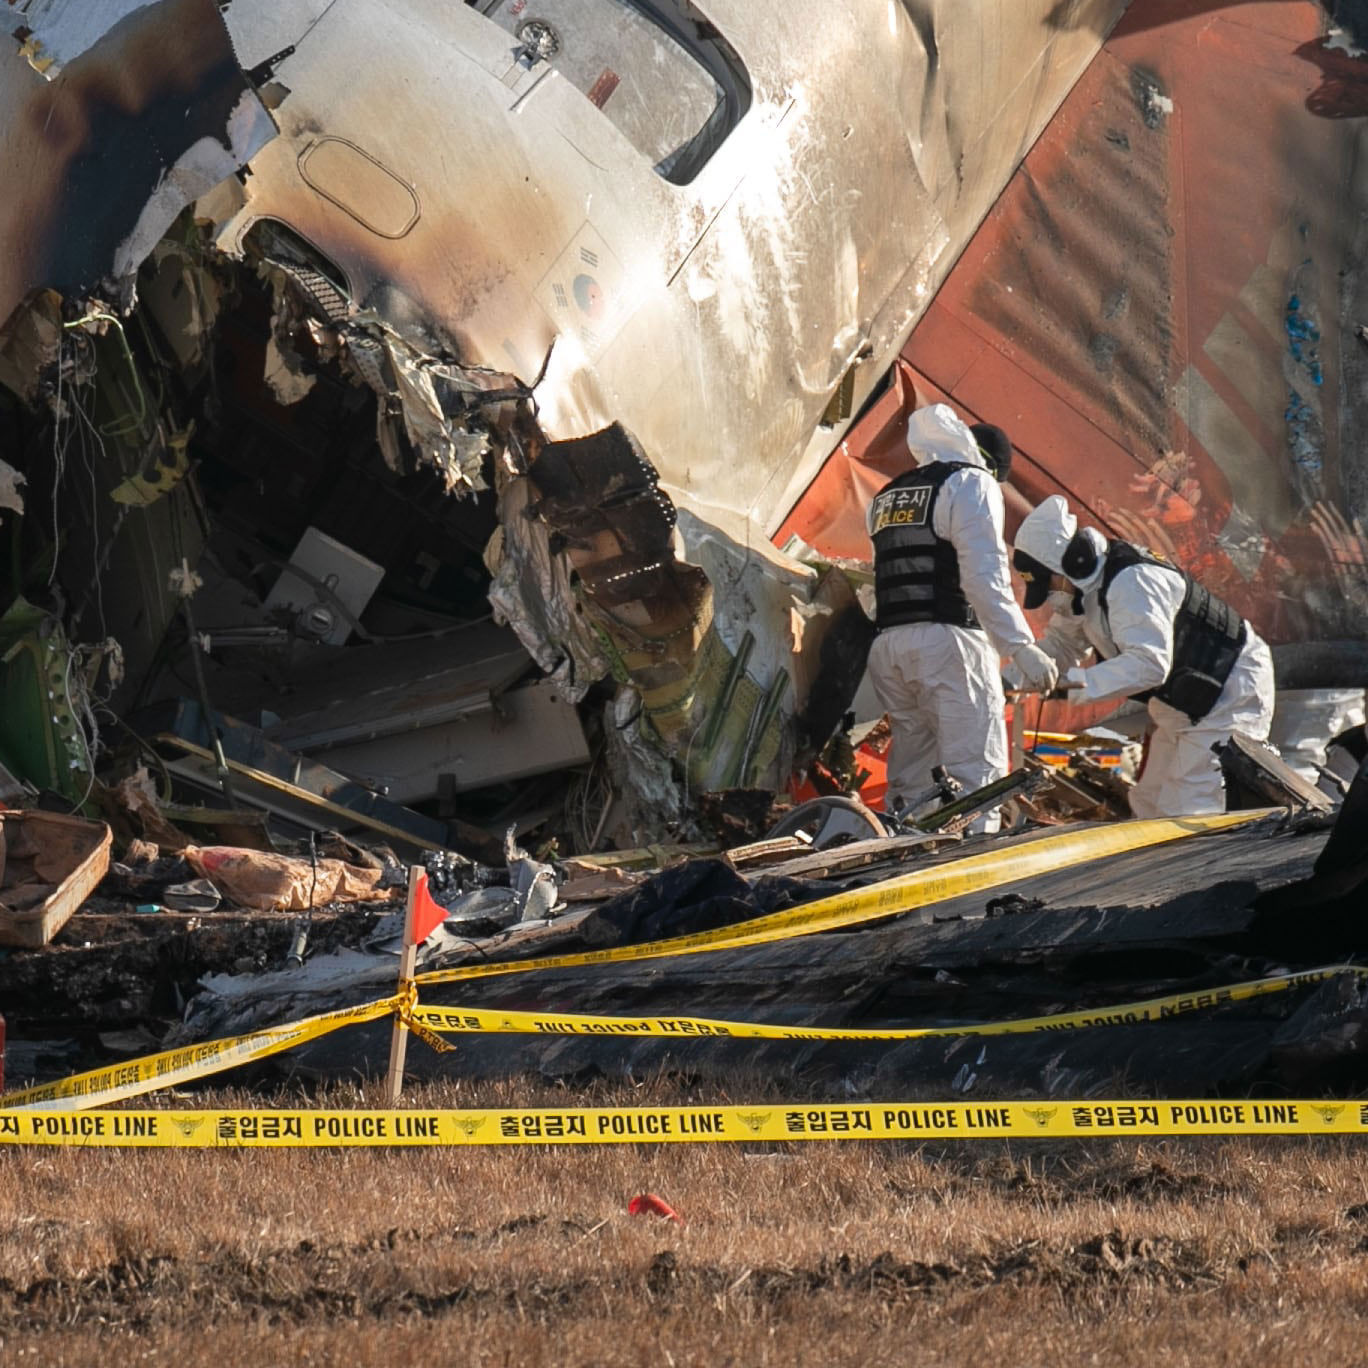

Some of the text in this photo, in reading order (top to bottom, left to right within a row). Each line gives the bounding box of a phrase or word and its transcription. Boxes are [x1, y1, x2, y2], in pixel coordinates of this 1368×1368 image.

[32, 1117, 105, 1136] POLICE
[113, 1117, 157, 1136] LINE
[219, 1116, 438, 1139] 출입금지 POLICE LINE
[501, 1114, 723, 1137] 출입금지 POLICE LINE
[786, 1109, 1011, 1132] 출입금지 POLICE LINE
[1072, 1105, 1299, 1127] 출입금지 POLICE LINE
